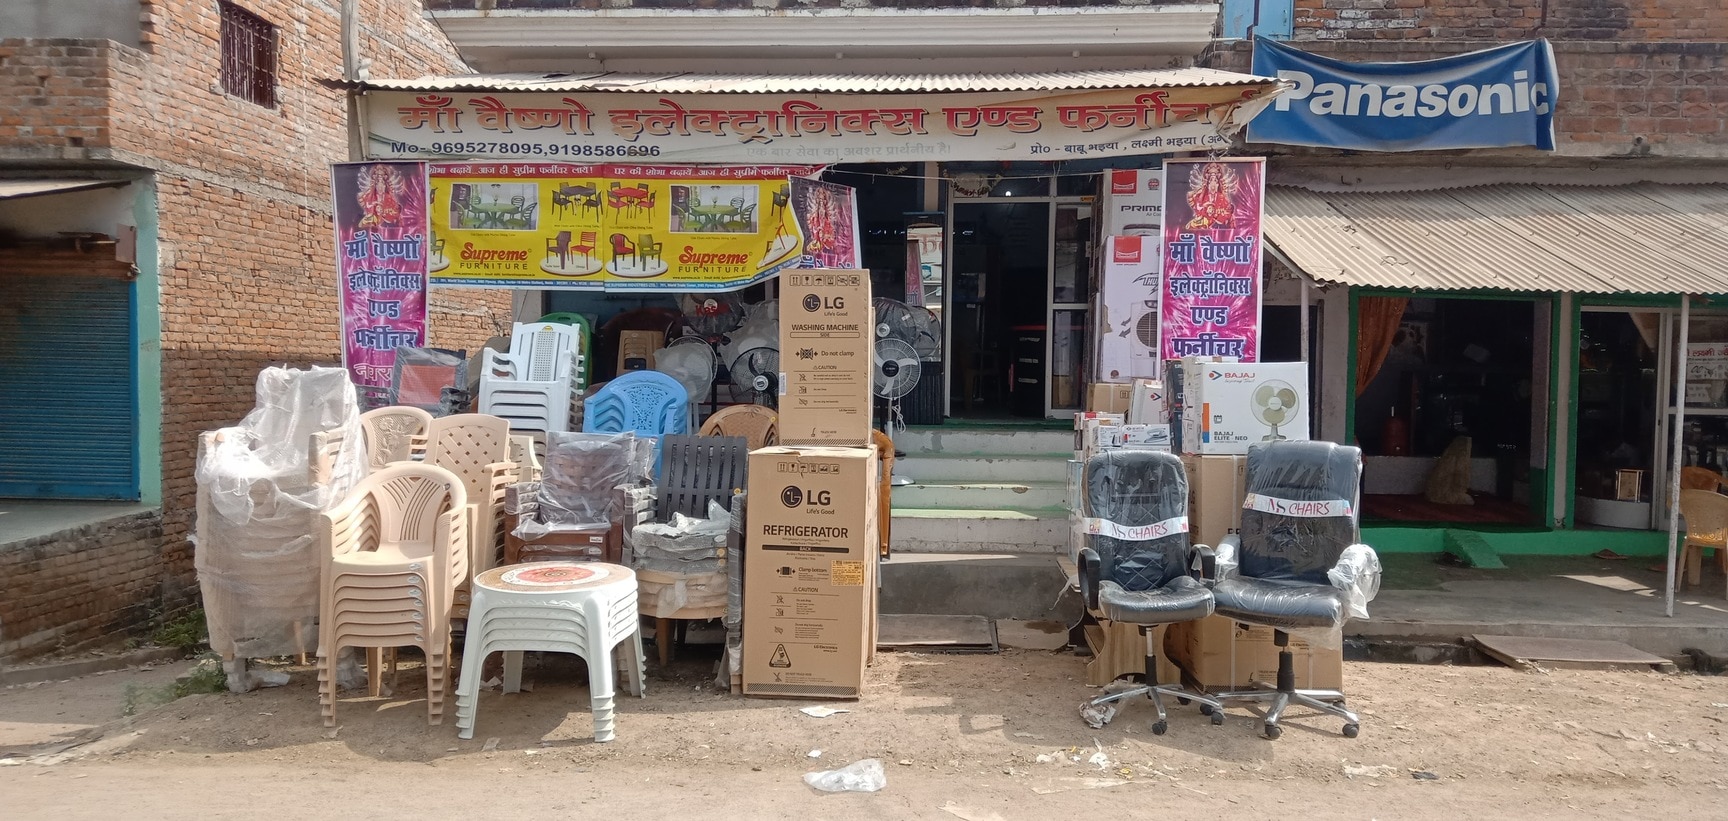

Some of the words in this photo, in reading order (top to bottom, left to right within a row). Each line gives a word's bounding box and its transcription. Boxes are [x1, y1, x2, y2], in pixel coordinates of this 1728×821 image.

[1275, 69, 1550, 117] Panasonic
[398, 95, 460, 133] माँ
[469, 97, 595, 136] वैष्णो
[942, 105, 1044, 136] एण्ड
[1064, 144, 1087, 155] बाबू
[1131, 136, 1163, 149] लक्ष्मी
[344, 230, 368, 260] माँ
[460, 242, 528, 265] Supreme
[1169, 234, 1195, 263] माँ
[459, 262, 528, 270] FURNITURE
[679, 245, 749, 269] Supreme
[678, 265, 746, 273] FURNITURE
[366, 299, 400, 318] एण्ड
[824, 296, 844, 309] LG
[1190, 306, 1229, 325] एण्ड
[839, 350, 855, 359] clamp
[806, 490, 831, 506] LG
[1288, 502, 1330, 515] CHAIRS
[763, 525, 849, 539] REFRIGERATOR
[1127, 521, 1168, 540] CHAIRS
